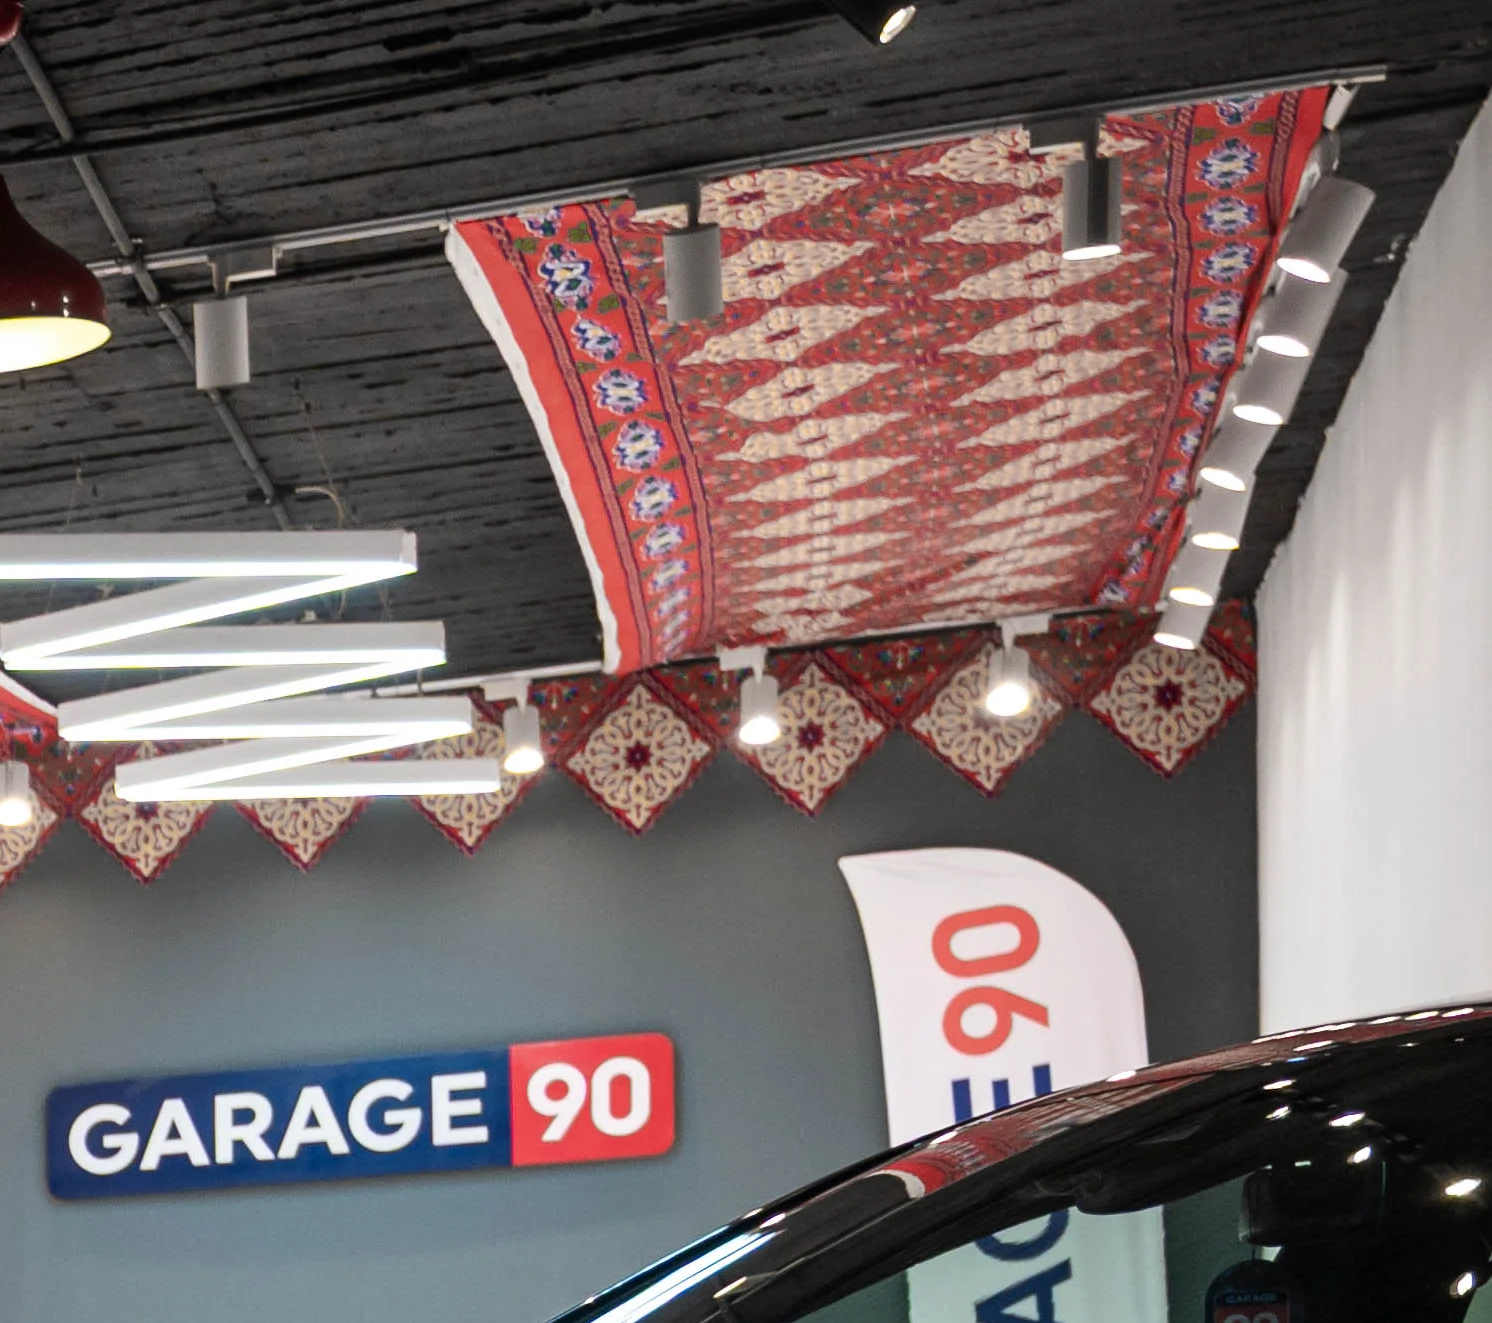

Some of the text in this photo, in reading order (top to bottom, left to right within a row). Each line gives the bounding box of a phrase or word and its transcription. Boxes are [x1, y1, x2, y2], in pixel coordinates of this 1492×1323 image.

[931, 904, 1050, 1057] 90
[67, 1054, 652, 1177] GARAGE 90
